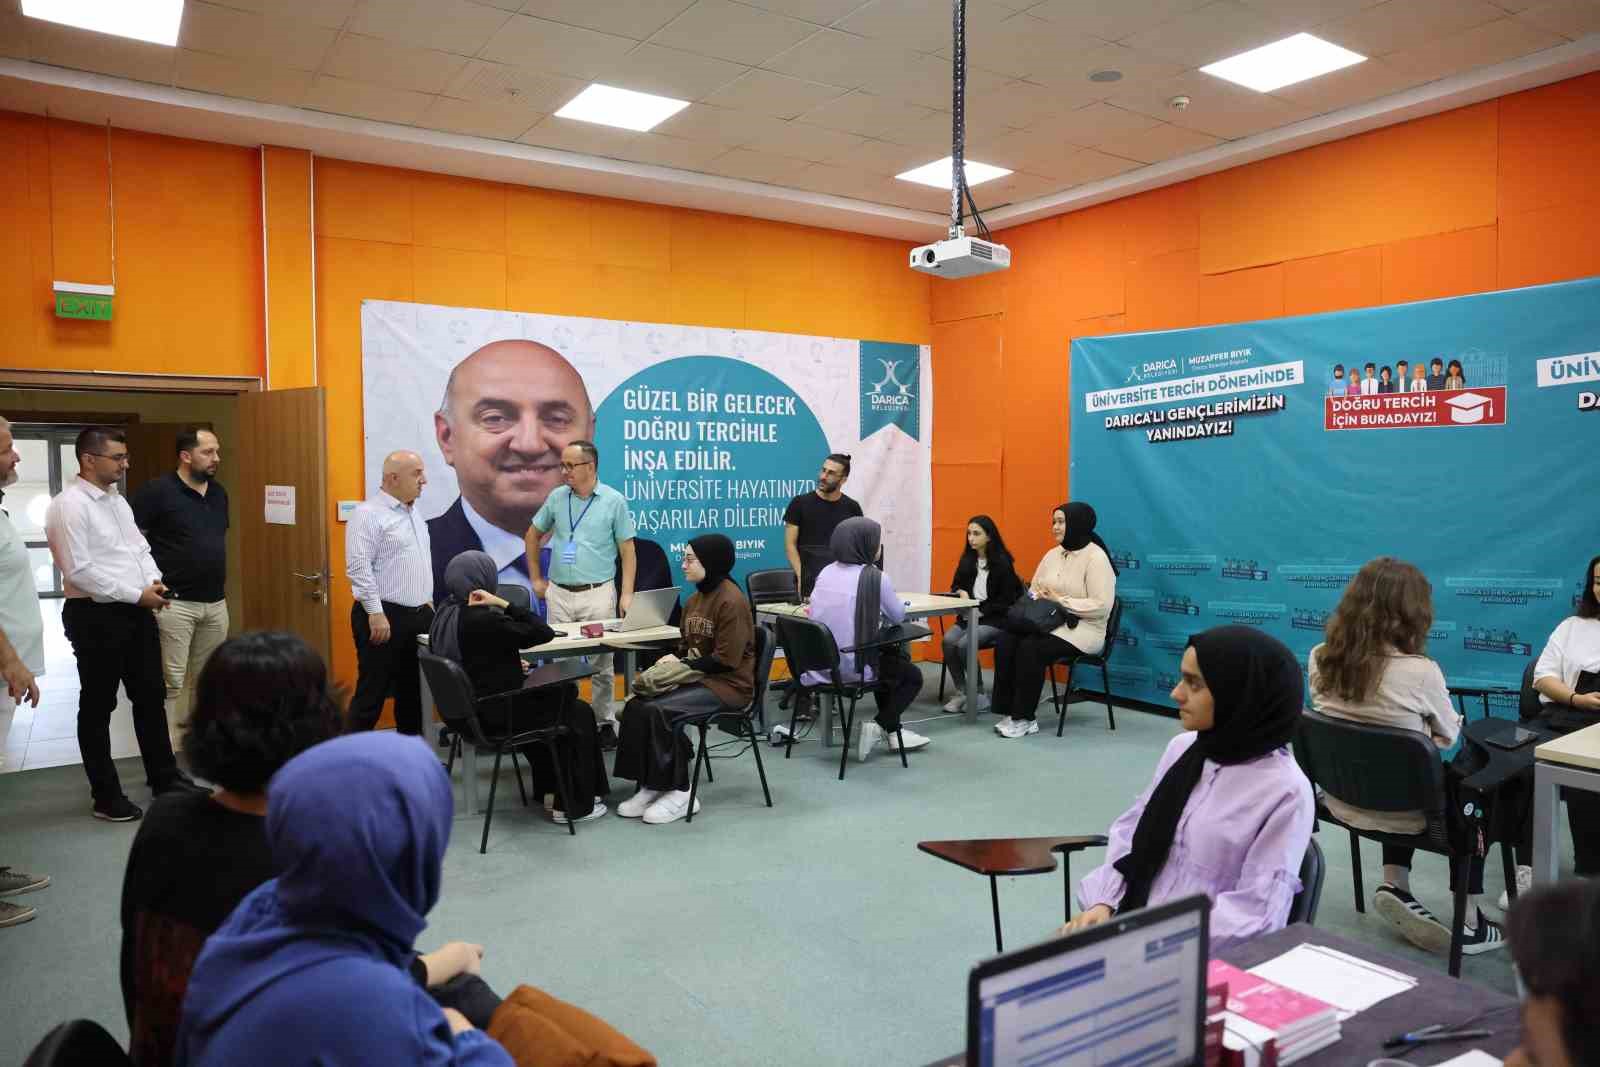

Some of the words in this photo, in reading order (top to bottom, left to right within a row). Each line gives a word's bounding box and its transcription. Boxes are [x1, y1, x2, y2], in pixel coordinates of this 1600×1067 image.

[61, 297, 109, 316] EXIT
[1143, 359, 1177, 373] DARICA
[1092, 387, 1158, 408] ÜNİVERSİTE
[1159, 380, 1205, 401] TERCİH
[1208, 366, 1295, 391] DÖNEMİNDE
[623, 385, 681, 412] GÜZEL
[687, 388, 718, 413] BİR
[724, 394, 797, 416] GELECEK
[871, 394, 910, 405] DARICA
[1332, 395, 1381, 412] DOĞRU
[1384, 392, 1436, 409] TERCİH
[1105, 409, 1165, 429] DARICA'LI
[1167, 393, 1284, 423] GENÇLERİMİZİN
[1332, 413, 1358, 429] İÇİN
[1360, 411, 1437, 425] BURADAYIZ!
[624, 415, 690, 441] DOĞRU
[696, 417, 777, 443] TERCİHLE
[1146, 420, 1233, 441] YANINDAYIZ!
[624, 446, 669, 477] İNŞA
[675, 446, 736, 471] EDİLİR.
[624, 474, 722, 501] ÜNİVERSİTE
[728, 478, 817, 500] HAYATINIZD
[735, 539, 766, 550] BIYIK
